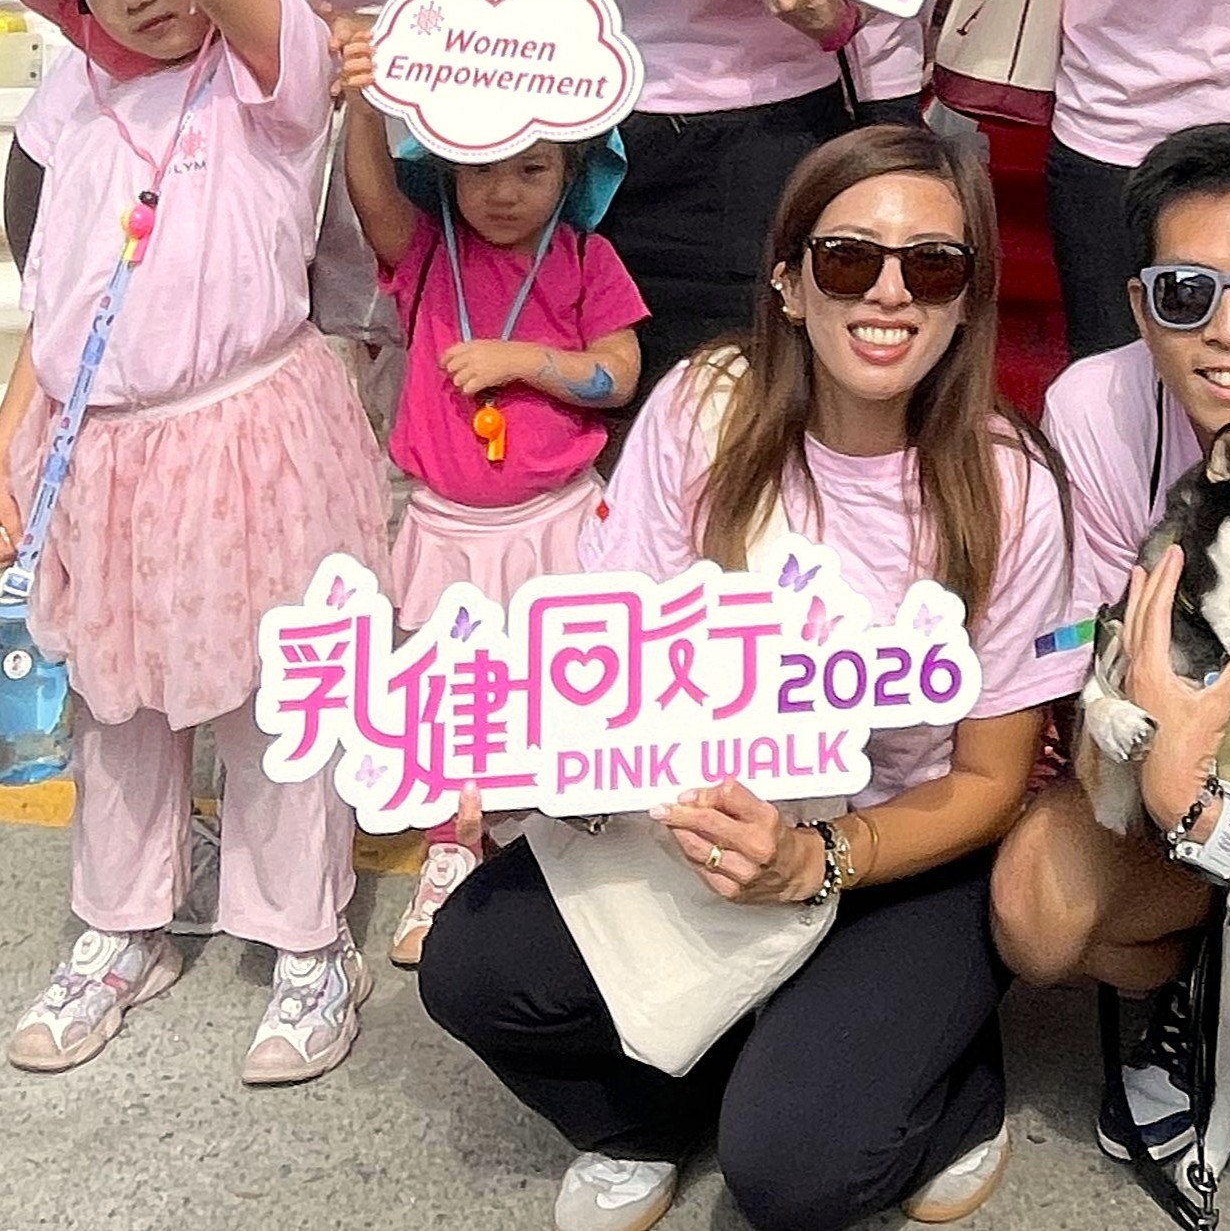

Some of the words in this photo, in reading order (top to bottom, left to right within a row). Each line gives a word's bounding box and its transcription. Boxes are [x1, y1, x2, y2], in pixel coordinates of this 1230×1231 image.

[444, 28, 556, 62] Women
[386, 55, 609, 99] Empowerment
[278, 583, 783, 812] 乳健同行
[777, 642, 964, 714] 2026
[556, 742, 681, 796] PINK
[700, 730, 851, 786] WALK
